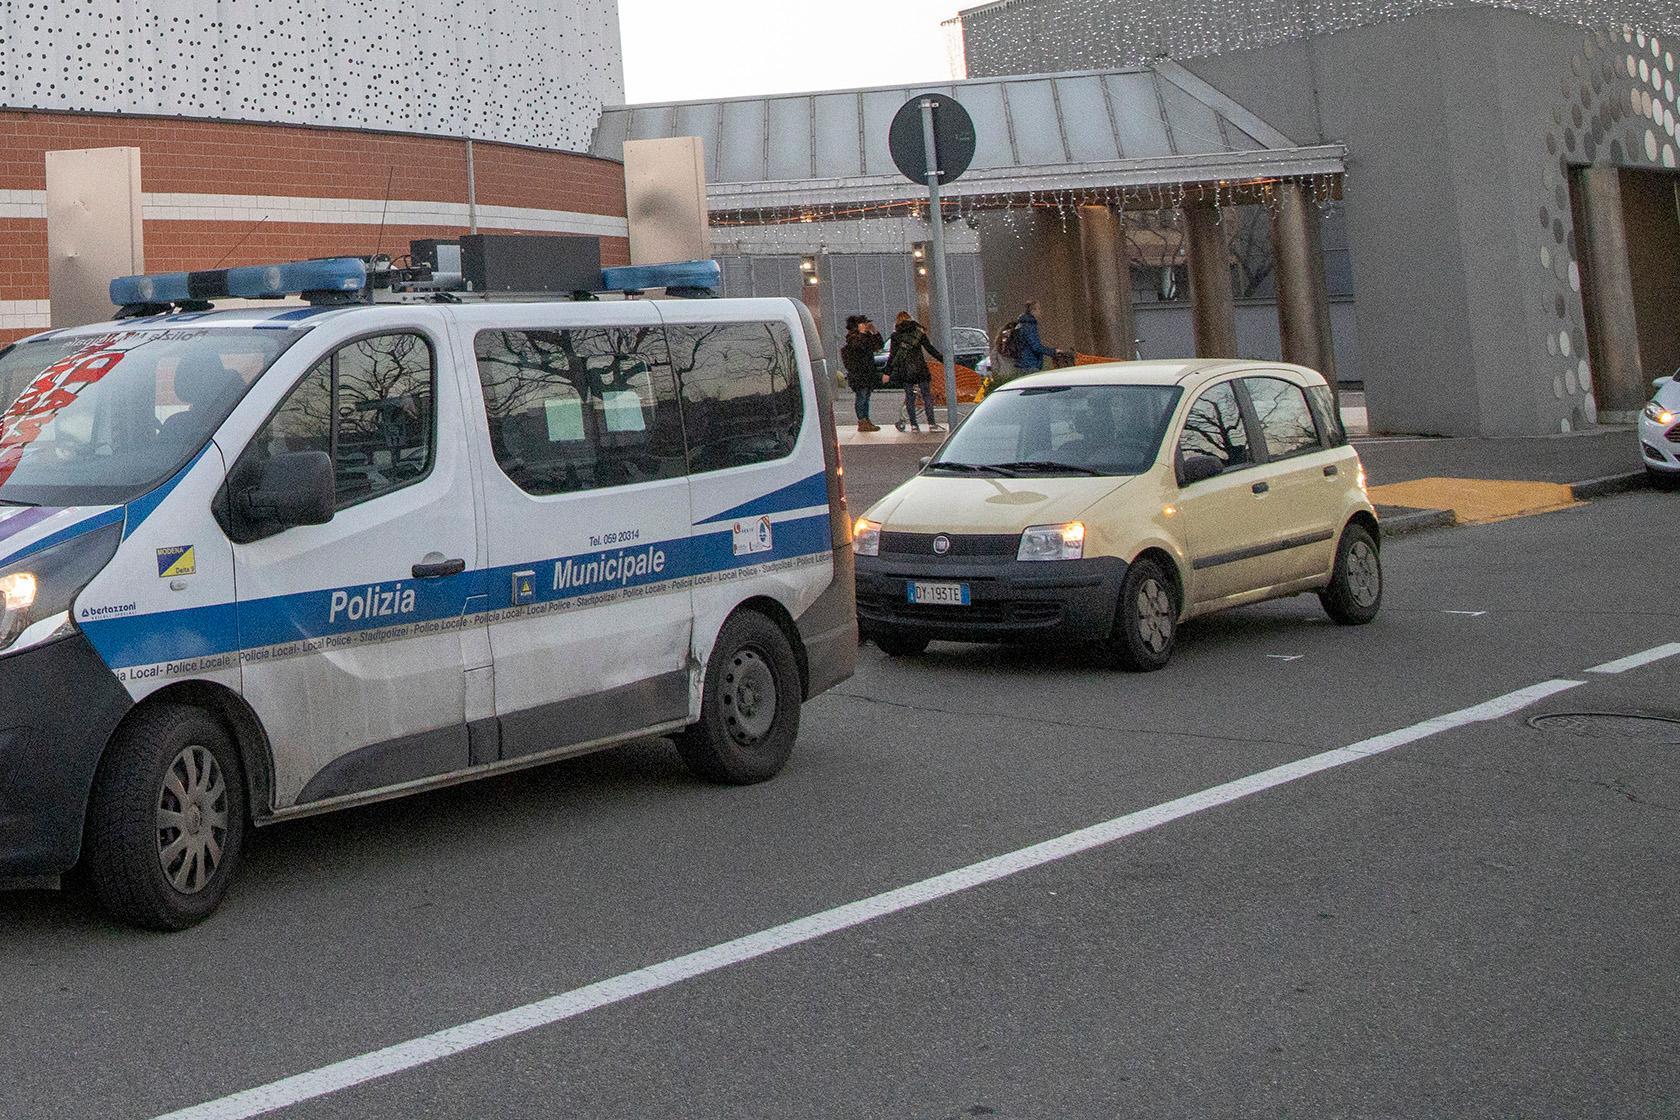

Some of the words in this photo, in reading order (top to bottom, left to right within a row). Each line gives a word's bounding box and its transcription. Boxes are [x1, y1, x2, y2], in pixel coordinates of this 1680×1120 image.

[589, 536, 601, 547] Tel.
[603, 533, 617, 545] 059
[618, 529, 640, 542] 20314
[157, 546, 184, 556] MODENA
[175, 566, 190, 574] Delta
[328, 583, 416, 624] Polizia
[552, 545, 666, 590] Municipale
[90, 601, 137, 616] bertazzoni
[166, 661, 198, 676] Police
[200, 654, 231, 670] Locale
[303, 637, 324, 653] Local
[326, 635, 352, 648] Police
[414, 621, 439, 635] Police
[549, 598, 570, 611] Police
